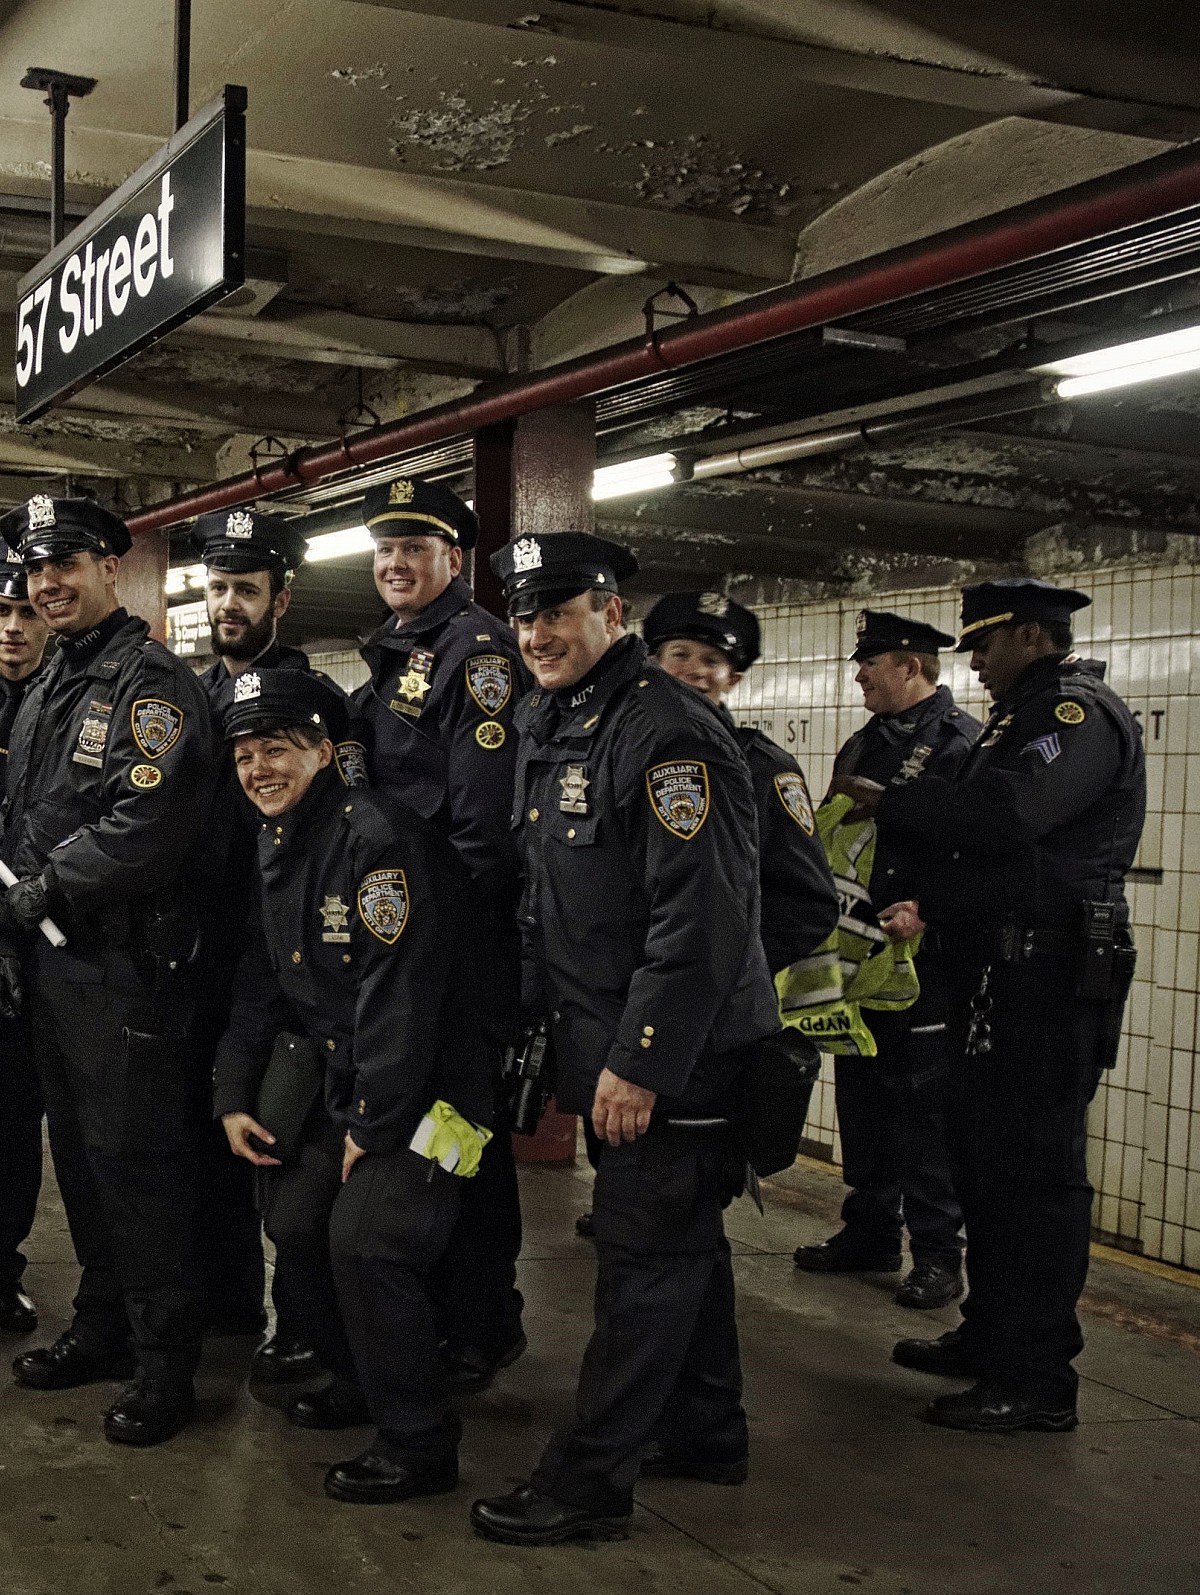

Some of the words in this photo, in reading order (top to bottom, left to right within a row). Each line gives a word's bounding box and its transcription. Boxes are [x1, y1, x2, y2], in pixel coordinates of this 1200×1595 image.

[16, 278, 52, 387] 57
[58, 171, 174, 354] Street
[147, 703, 171, 714] POLICE
[137, 709, 179, 725] DEPARTMENT
[787, 719, 809, 743] ST
[652, 764, 699, 780] AUXILIARY
[664, 776, 692, 787] POLICE
[656, 784, 703, 798] DEPARTMENT
[360, 872, 399, 888] AUXILIARY
[368, 883, 393, 894] POLICE
[361, 890, 404, 906] DEPARTMENT
[800, 1015, 851, 1032] NYPD
